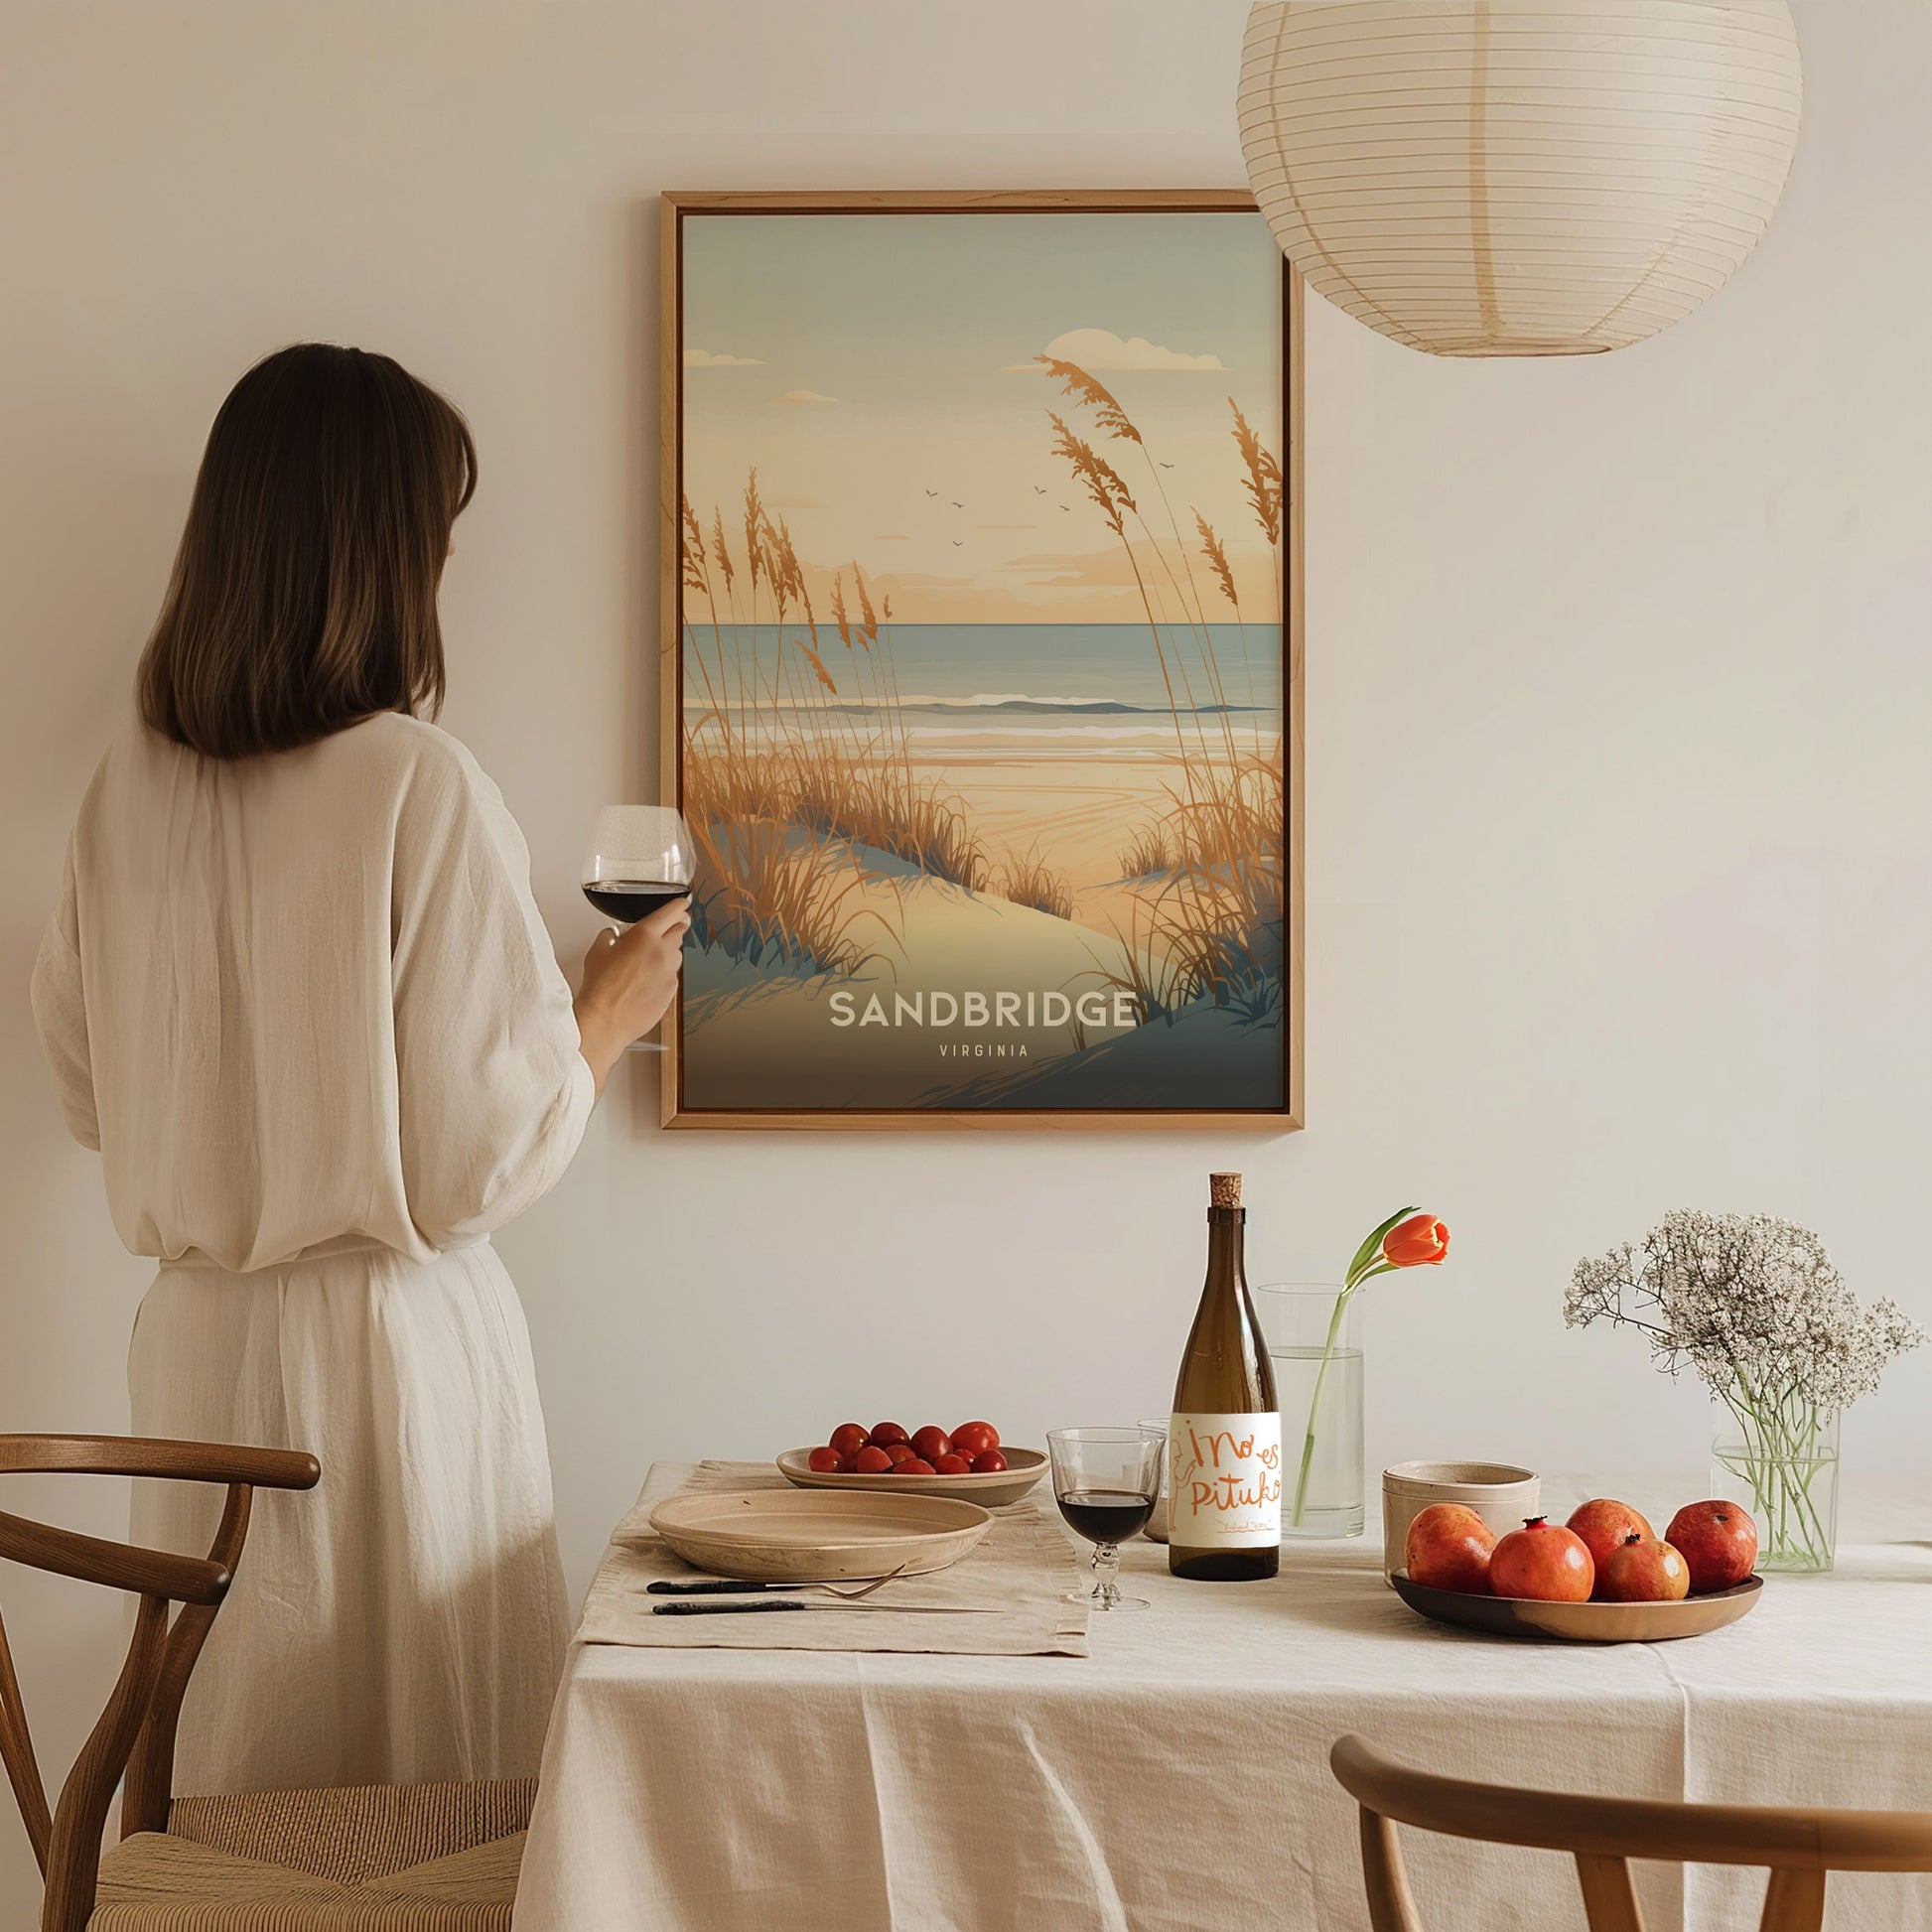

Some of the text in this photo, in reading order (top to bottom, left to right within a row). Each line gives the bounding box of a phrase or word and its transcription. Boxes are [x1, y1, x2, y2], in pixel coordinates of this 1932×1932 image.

[829, 991, 1137, 1028] SANDBRIDGE
[939, 1044, 1029, 1057] VIRGINIA
[1256, 1444, 1279, 1470] es
